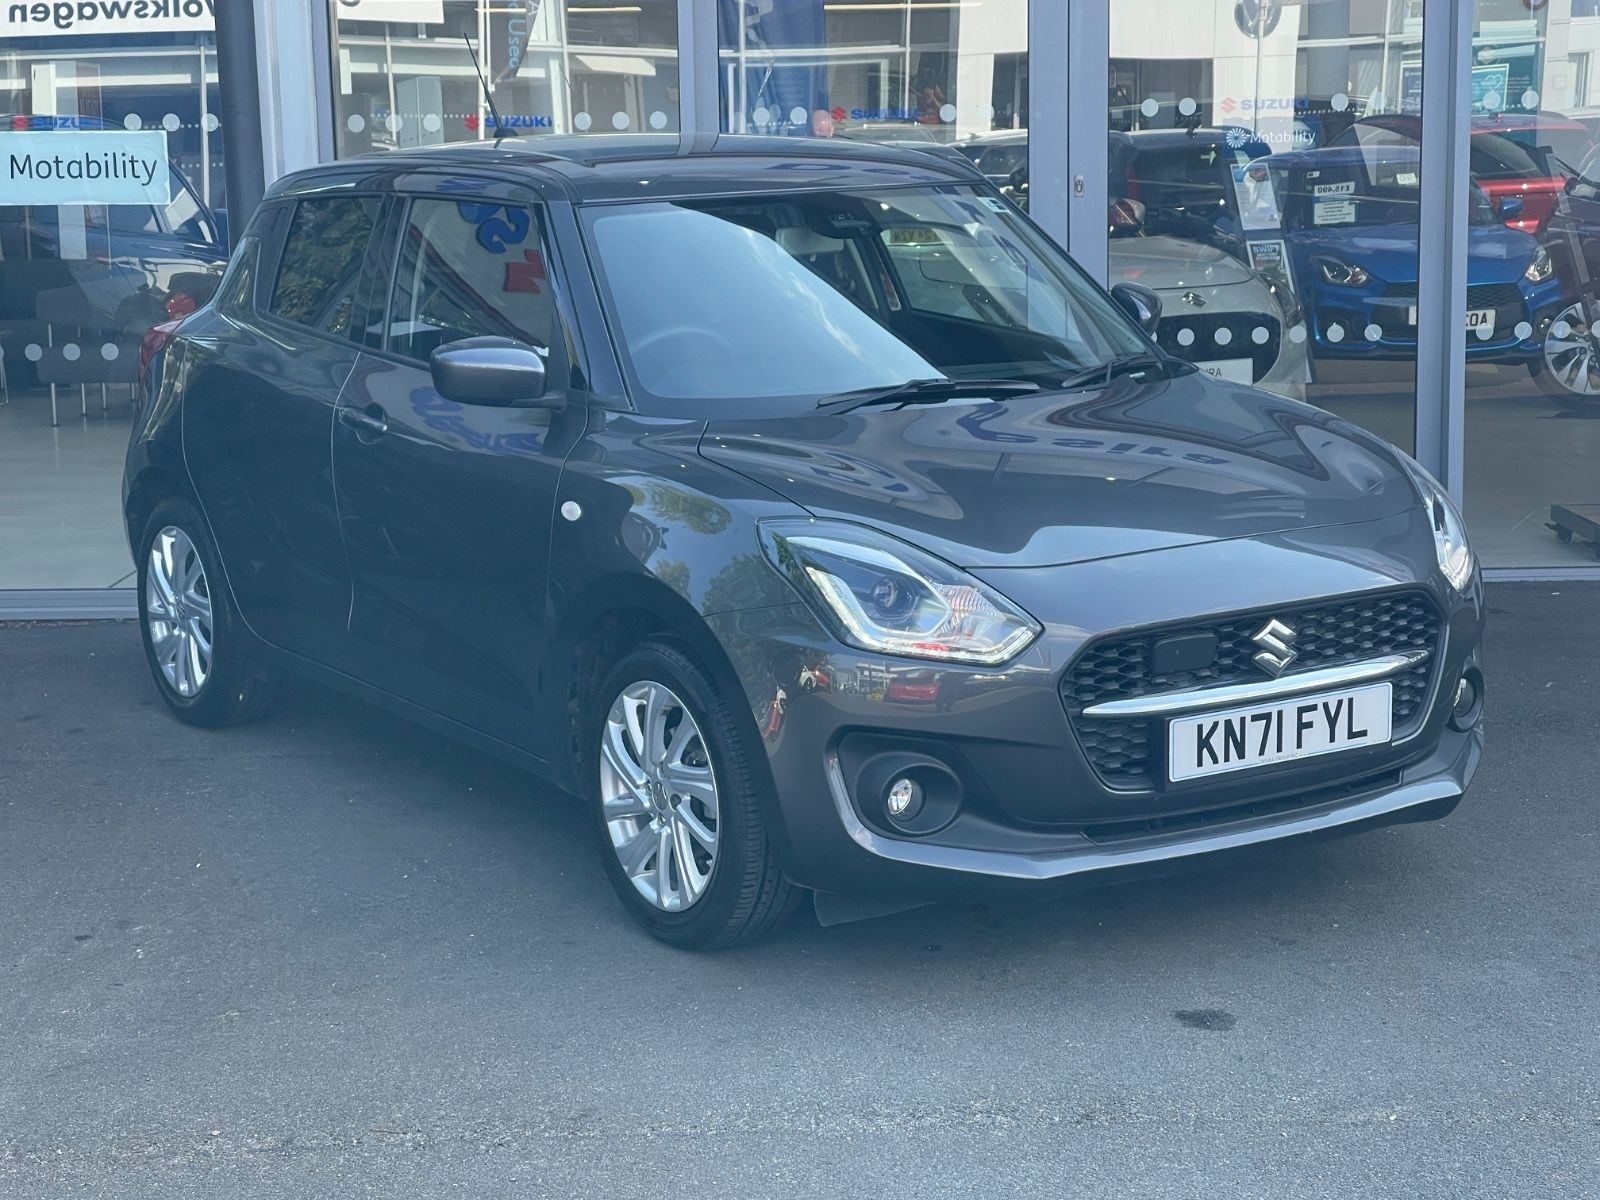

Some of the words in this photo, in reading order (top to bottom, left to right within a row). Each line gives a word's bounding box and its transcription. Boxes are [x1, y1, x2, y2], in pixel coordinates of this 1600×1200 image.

[1240, 97, 1309, 110] SUZUKI
[31, 116, 101, 129] SUZU
[1250, 130, 1316, 145] Motability
[10, 152, 158, 186] Motability
[1465, 312, 1487, 326] OA
[1197, 710, 1283, 768] KN71
[1296, 697, 1368, 749] FYL
